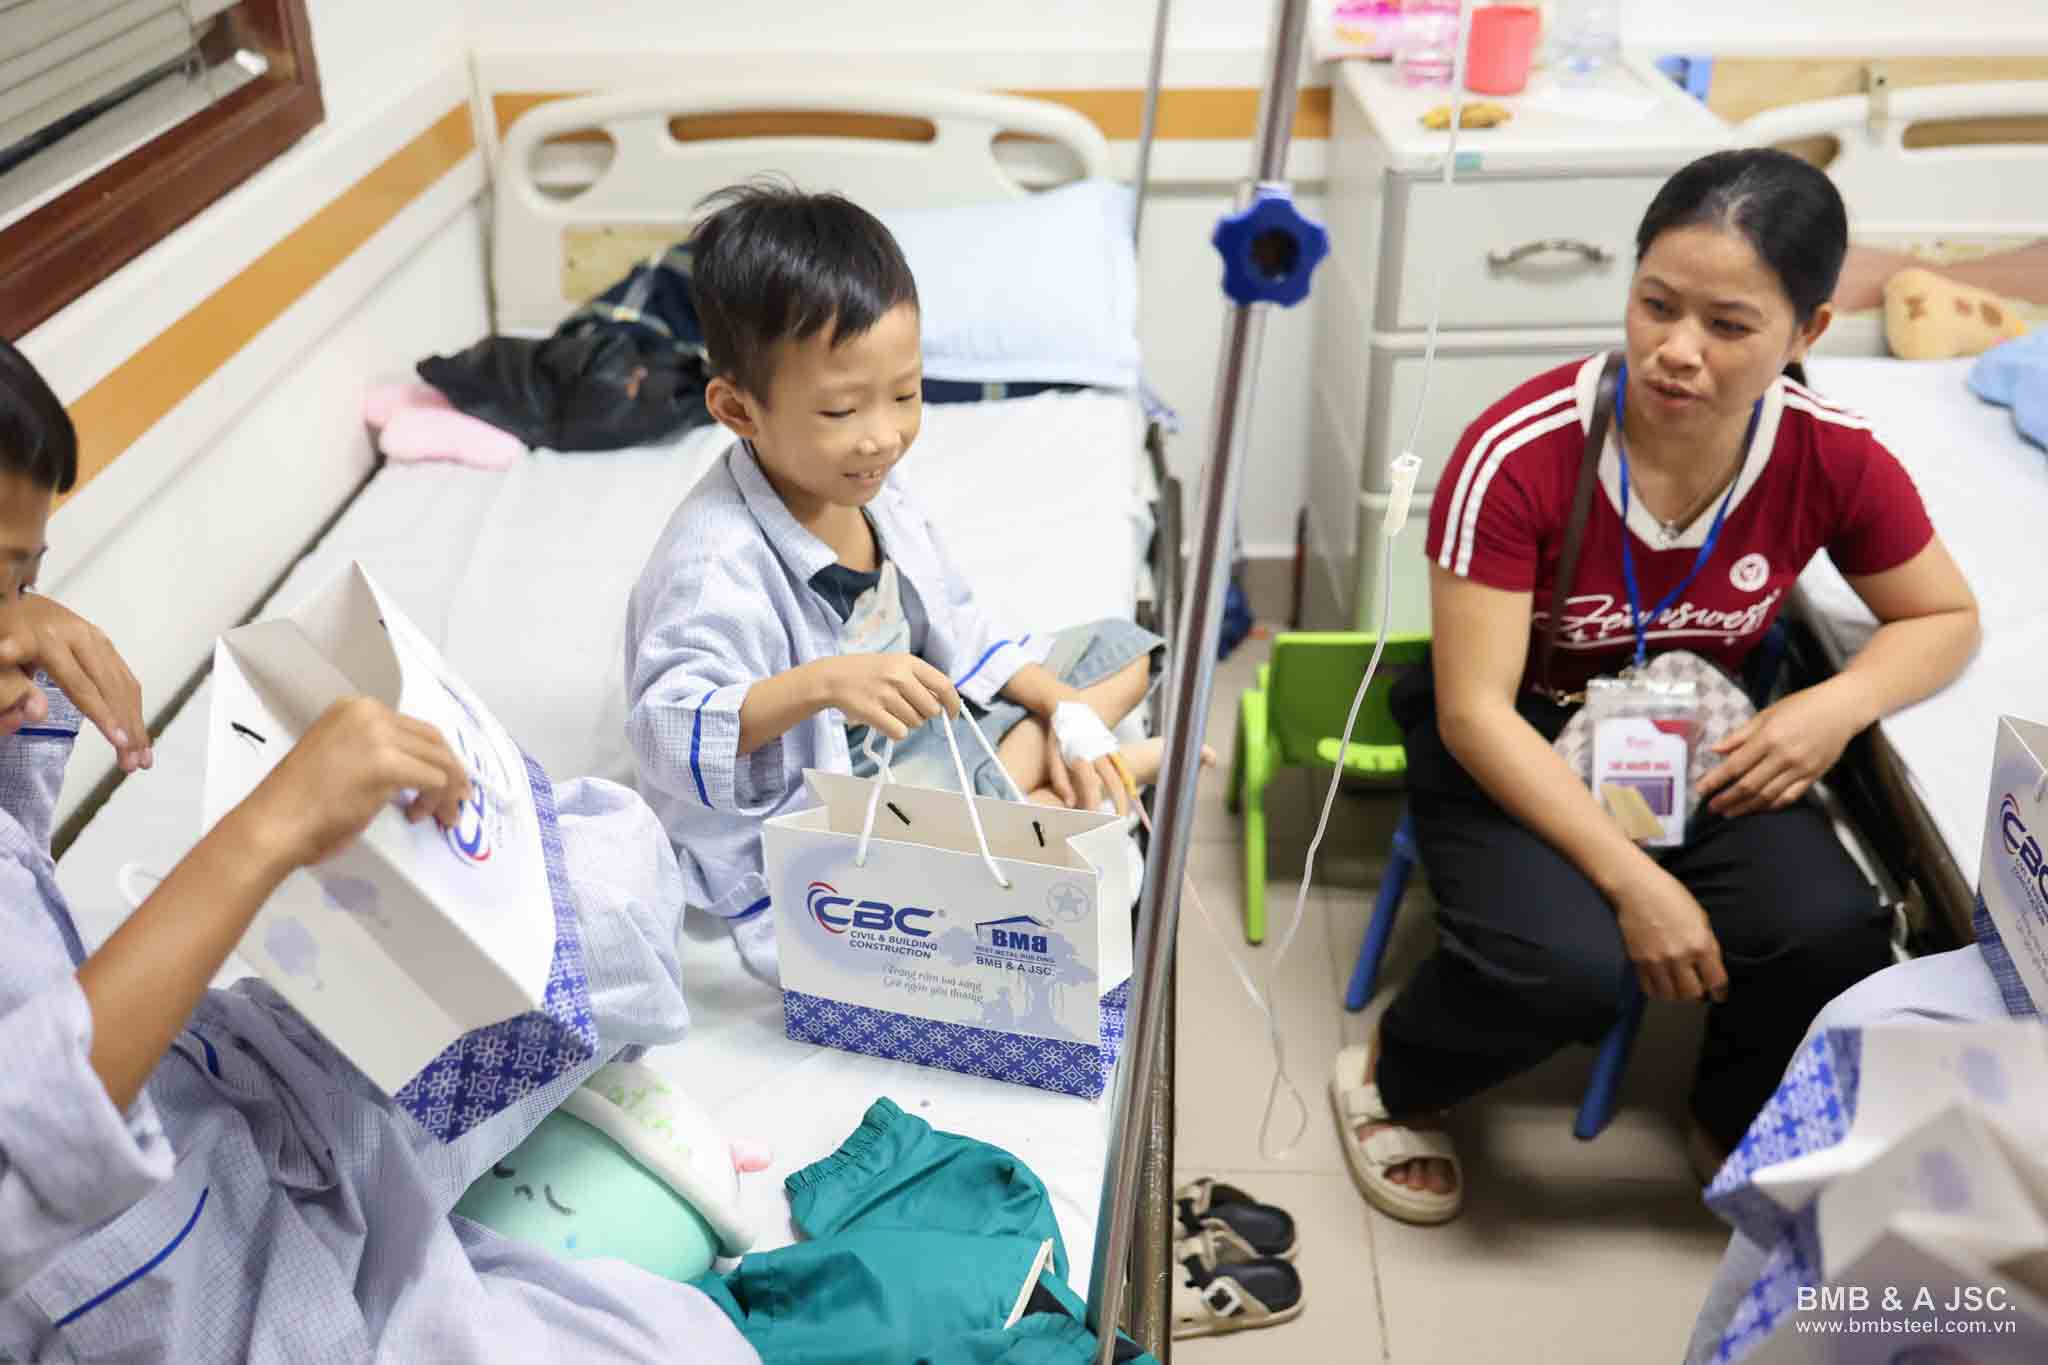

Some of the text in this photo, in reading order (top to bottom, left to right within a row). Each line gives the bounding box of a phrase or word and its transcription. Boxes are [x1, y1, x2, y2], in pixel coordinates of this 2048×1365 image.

[809, 890, 936, 938] CBC
[849, 940, 931, 959] CONSTRUCTION
[850, 930, 938, 951] CIVIL & BUILDING
[991, 928, 1047, 953] BMB
[976, 956, 1055, 977] BMB & A JSC.
